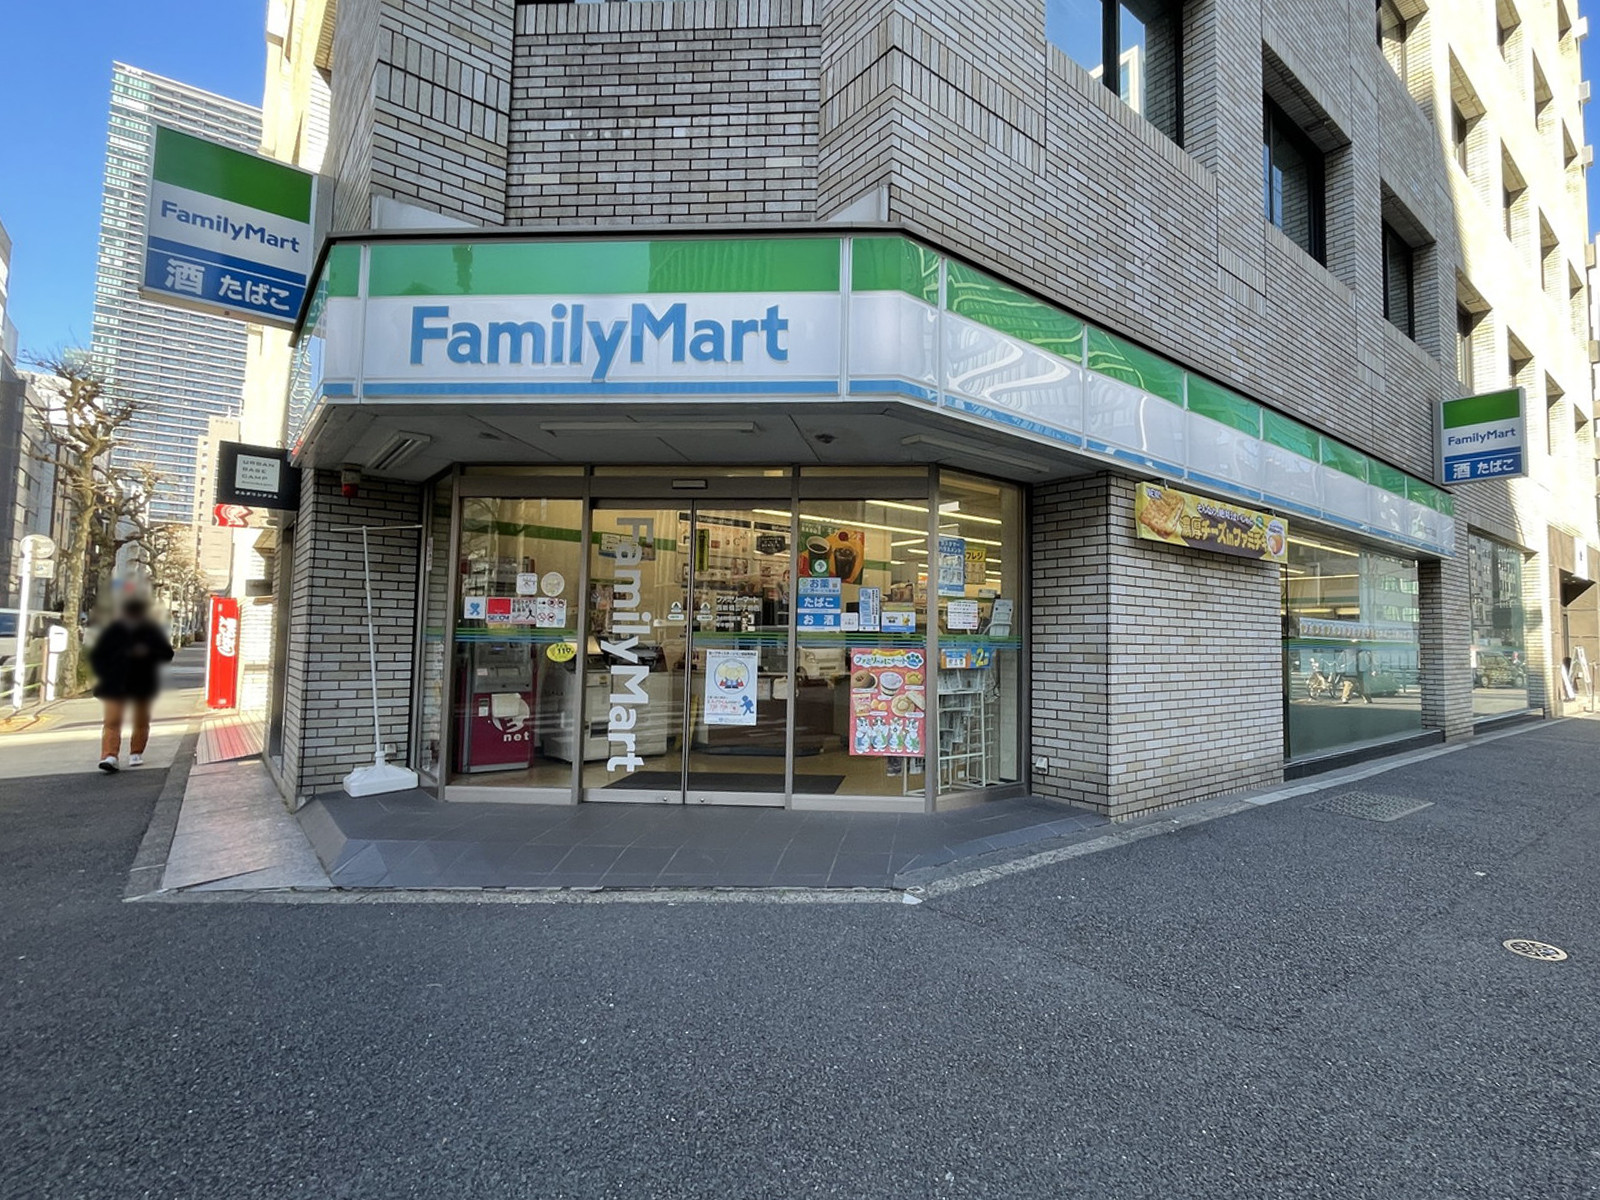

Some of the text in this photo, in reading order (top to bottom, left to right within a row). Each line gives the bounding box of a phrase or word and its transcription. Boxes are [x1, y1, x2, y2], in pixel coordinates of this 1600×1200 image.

[161, 200, 300, 253] FamilyMart
[164, 258, 290, 311] 酒 たばこ
[409, 302, 789, 384] FamilyMart
[1447, 427, 1517, 446] FamilyMart
[242, 460, 275, 468] URBAN
[1453, 459, 1515, 479] 酒 たばこ
[803, 596, 835, 608] たばこ
[803, 615, 814, 626] お
[600, 517, 654, 772] FamilyMart
